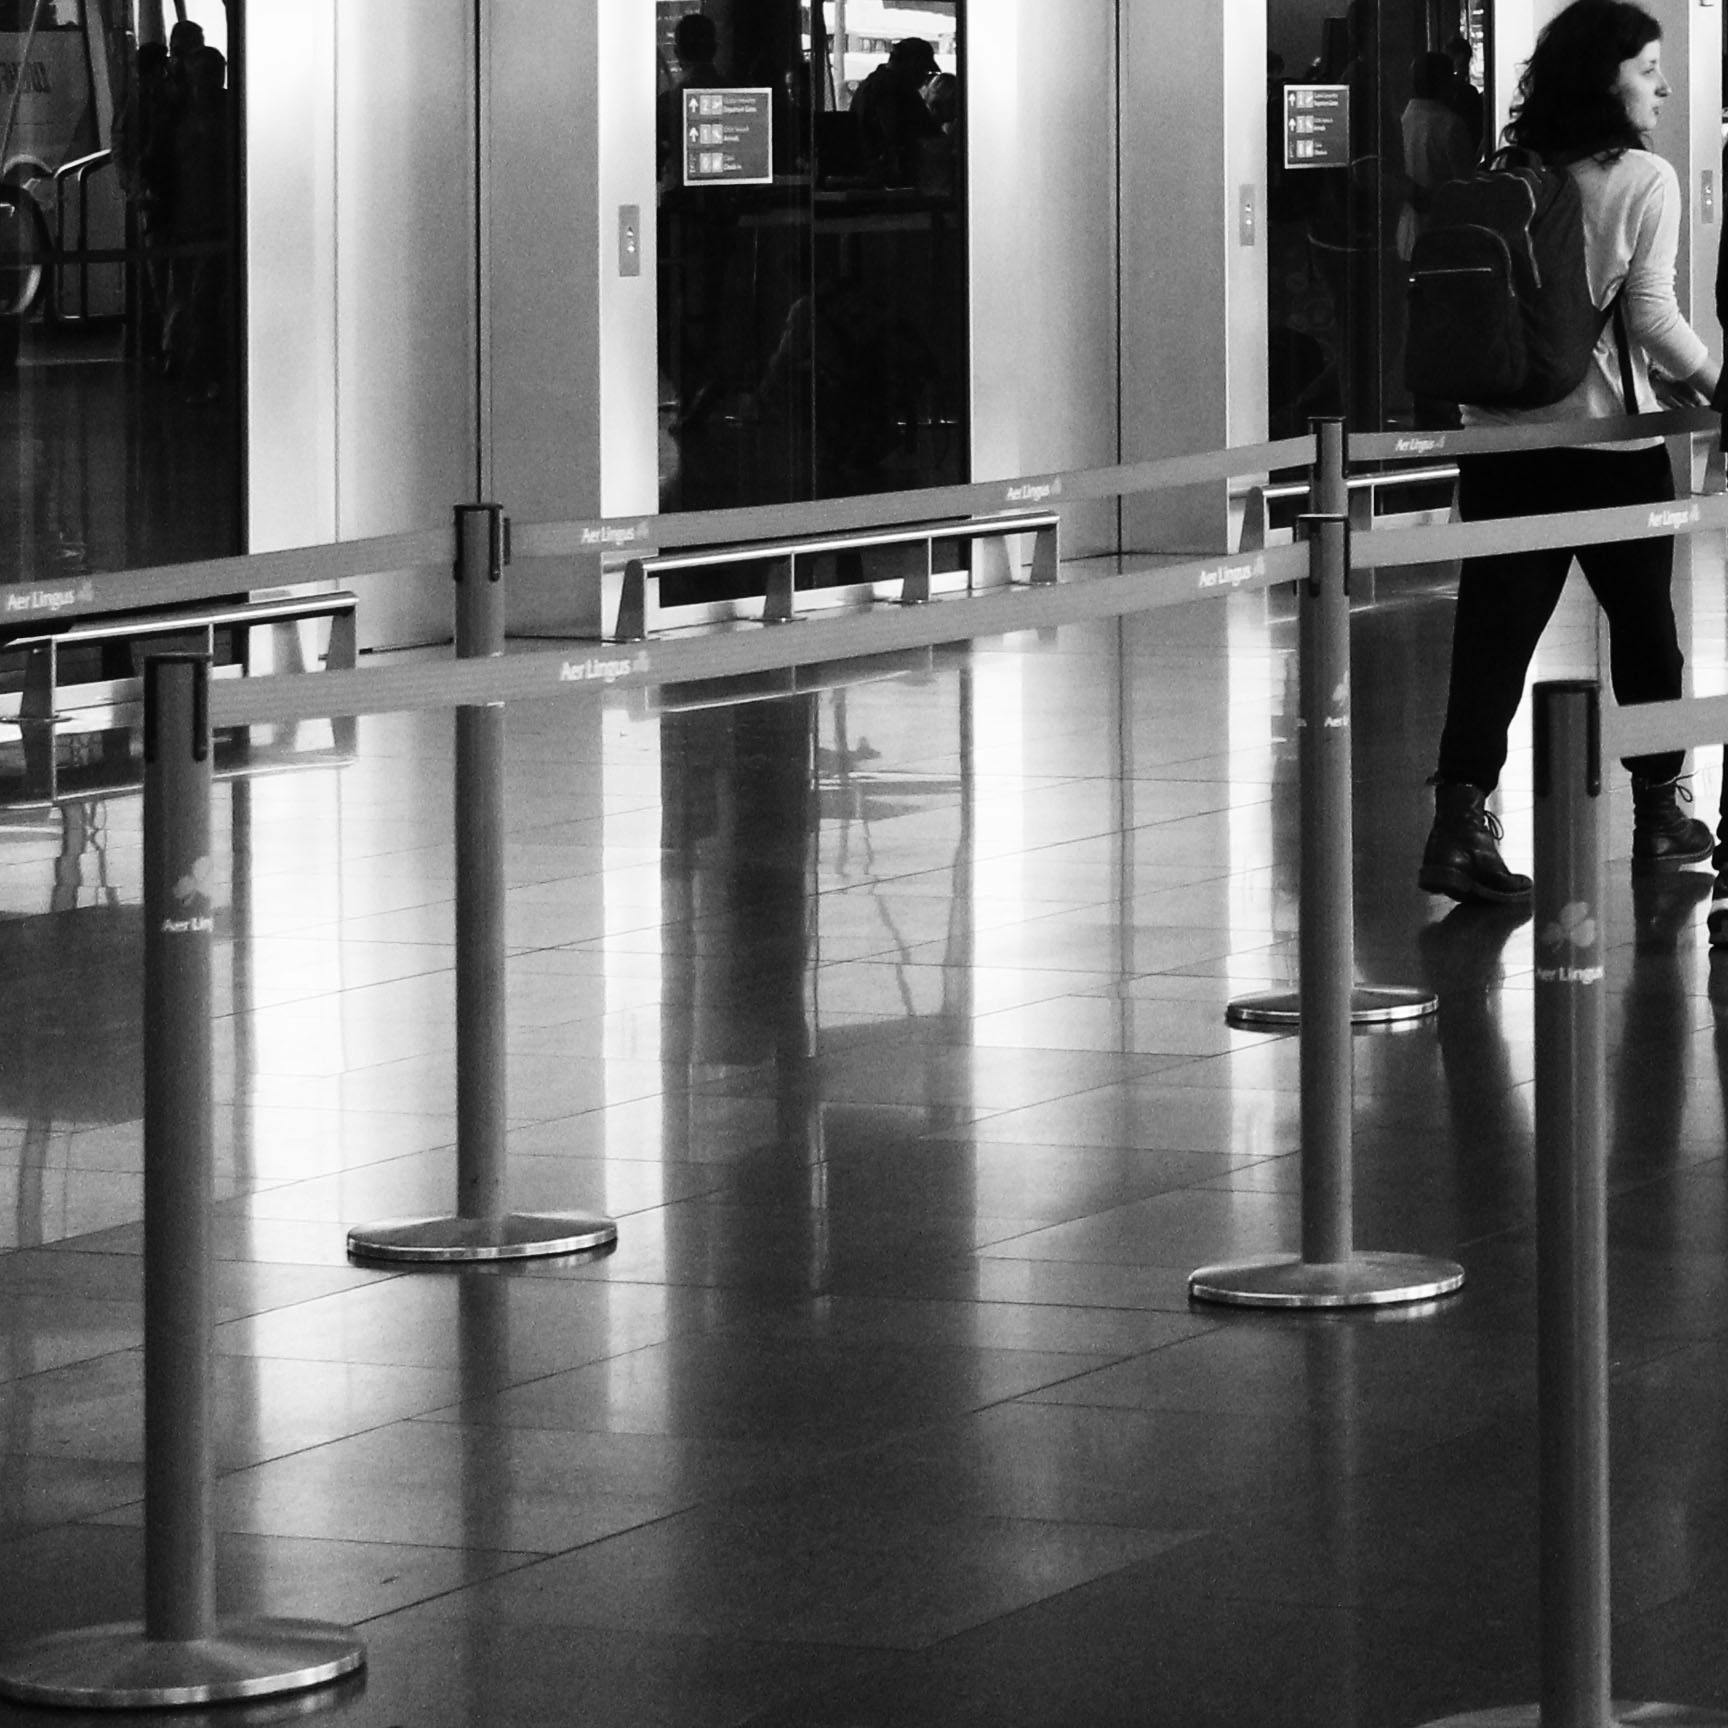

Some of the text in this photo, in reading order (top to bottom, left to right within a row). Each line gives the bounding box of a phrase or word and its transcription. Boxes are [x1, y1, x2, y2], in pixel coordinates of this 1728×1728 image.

[1006, 484, 1050, 502] Aer Lingus
[582, 526, 634, 546] Aer Lingus
[1199, 565, 1251, 588] Aer Lingus
[7, 590, 75, 612] Aer Lingus
[560, 659, 632, 684] Aer Lingus
[161, 918, 190, 932] Aer
[1559, 966, 1605, 985] Lingu
